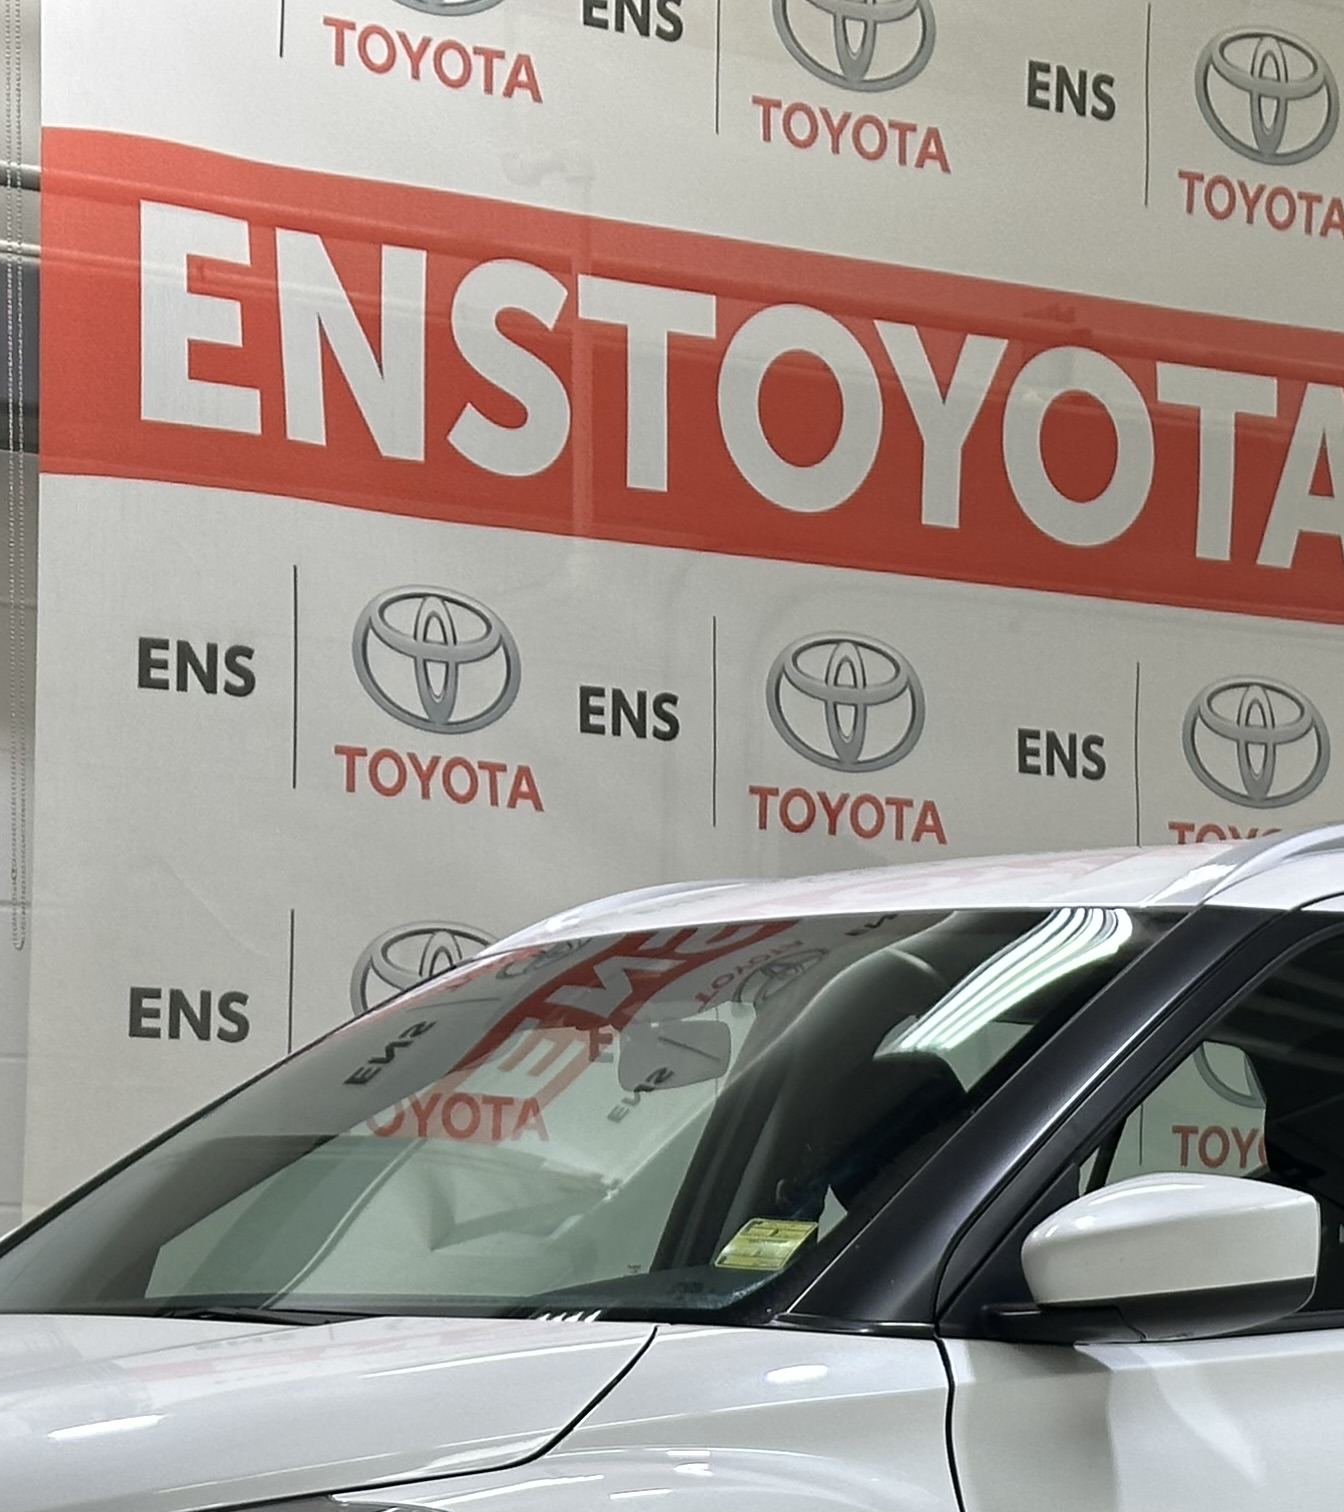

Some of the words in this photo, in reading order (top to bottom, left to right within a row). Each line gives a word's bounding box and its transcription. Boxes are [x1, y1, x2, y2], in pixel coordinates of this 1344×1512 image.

[582, 0, 684, 43] ENS
[323, 15, 543, 103] TOYOTA
[1026, 60, 1117, 122] ENS
[752, 96, 951, 173] TOYOTA
[137, 636, 256, 698] ENS
[579, 685, 680, 742] ENS
[334, 745, 544, 812] TOYOTA
[1017, 728, 1107, 782] ENS
[748, 785, 948, 844] TOYOTA
[128, 986, 250, 1044] ENS
[1171, 1124, 1269, 1169] TOY
